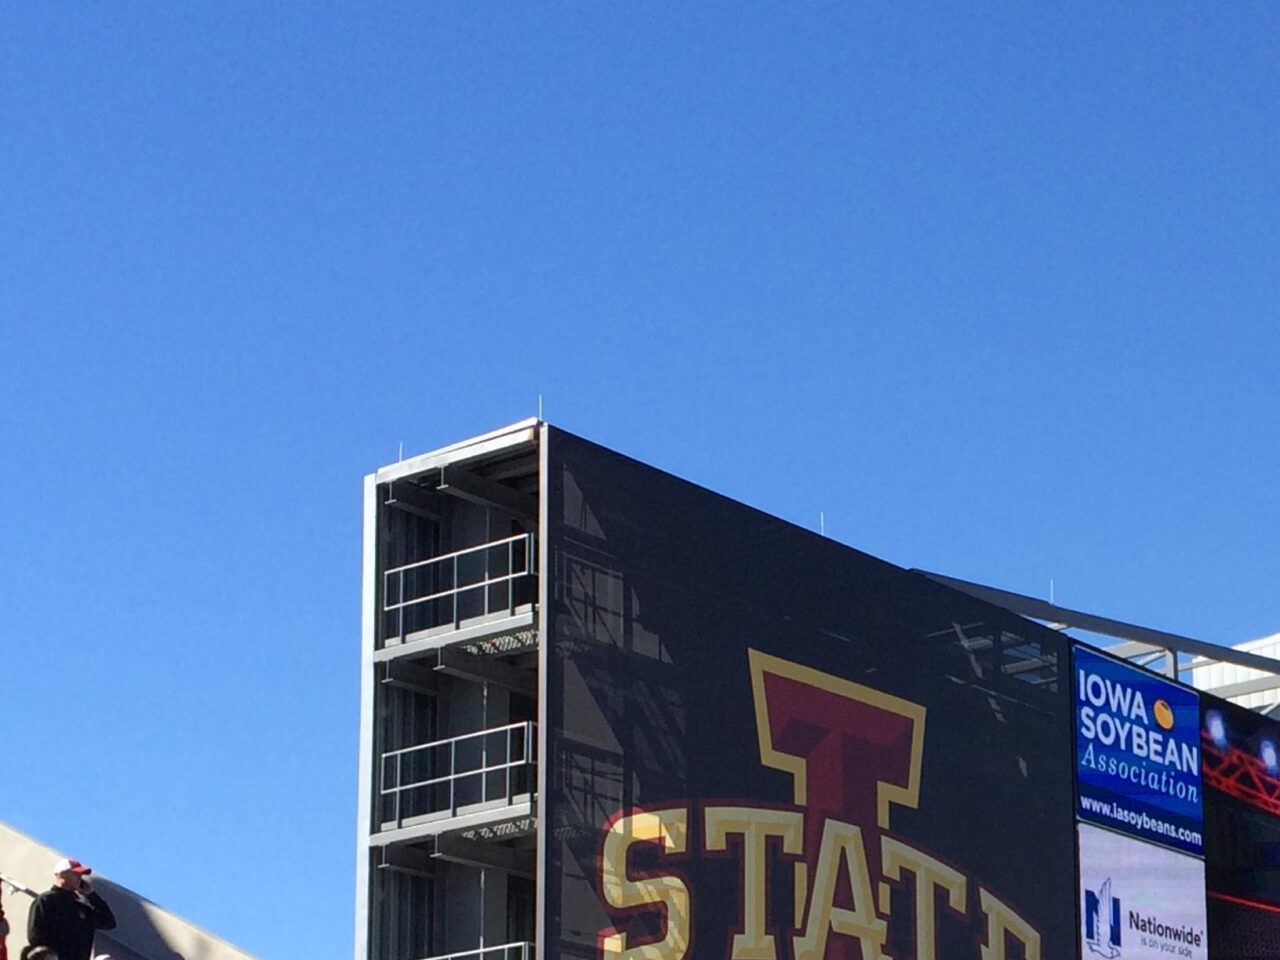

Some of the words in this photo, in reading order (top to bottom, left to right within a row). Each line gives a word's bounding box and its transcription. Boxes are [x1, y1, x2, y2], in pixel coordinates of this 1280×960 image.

[1079, 669, 1149, 724] IOWA
[1080, 706, 1198, 776] SOYBEAN
[1081, 742, 1199, 803] Association
[1080, 795, 1203, 846] www.iasoybeans.com
[1128, 910, 1202, 948] Nationwide
